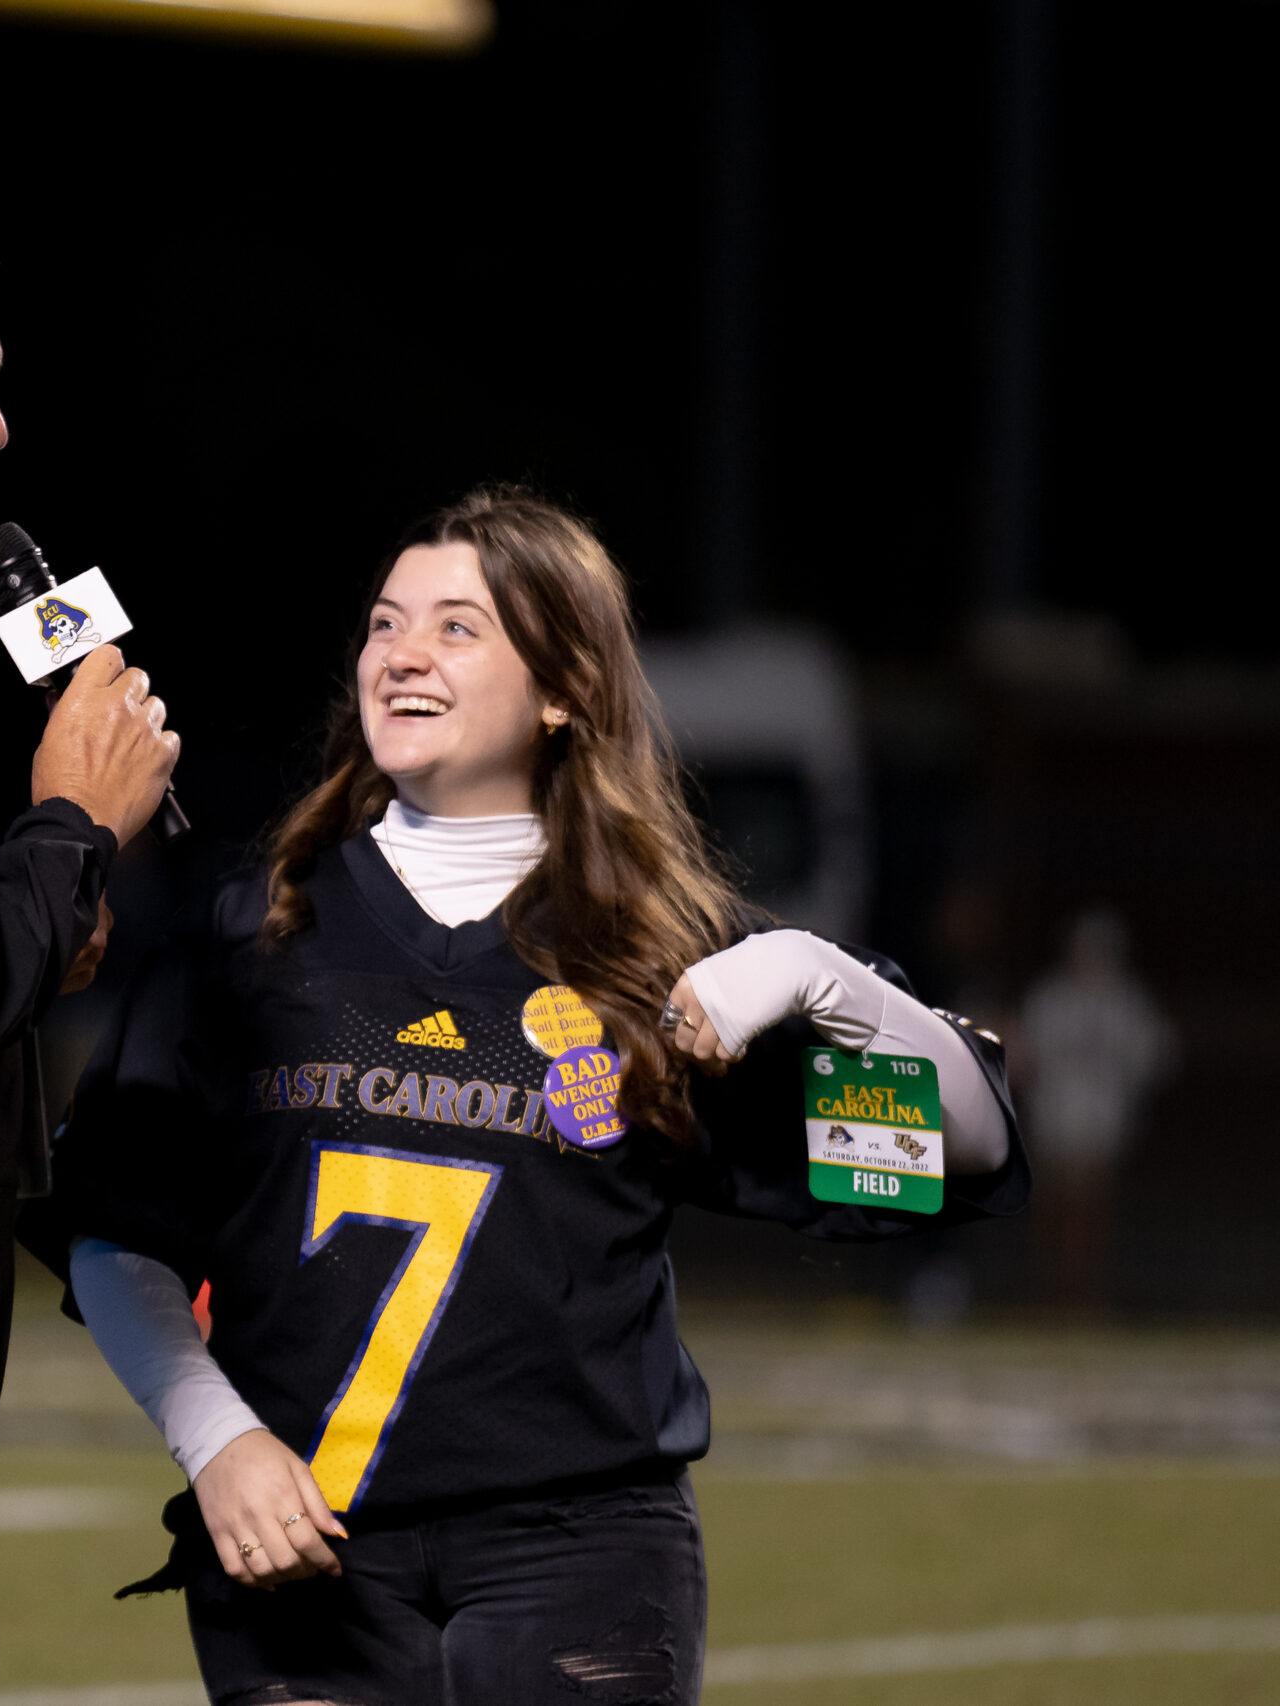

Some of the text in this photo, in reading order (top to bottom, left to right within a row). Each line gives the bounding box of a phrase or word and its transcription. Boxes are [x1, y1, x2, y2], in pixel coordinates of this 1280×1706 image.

[41, 603, 60, 621] ECU
[396, 1030, 466, 1050] adidas
[556, 1053, 612, 1086] BAD
[813, 1053, 921, 1076] 6 110
[843, 1084, 897, 1106] EAST
[816, 1097, 926, 1126] CAROLINA
[892, 1132, 928, 1161] UCF
[822, 1150, 863, 1164] SATURDAY,
[863, 1156, 896, 1168] OCTOBER
[911, 1160, 929, 1172] 2022
[852, 1170, 901, 1197] FIELD
[298, 1139, 505, 1516] 7
